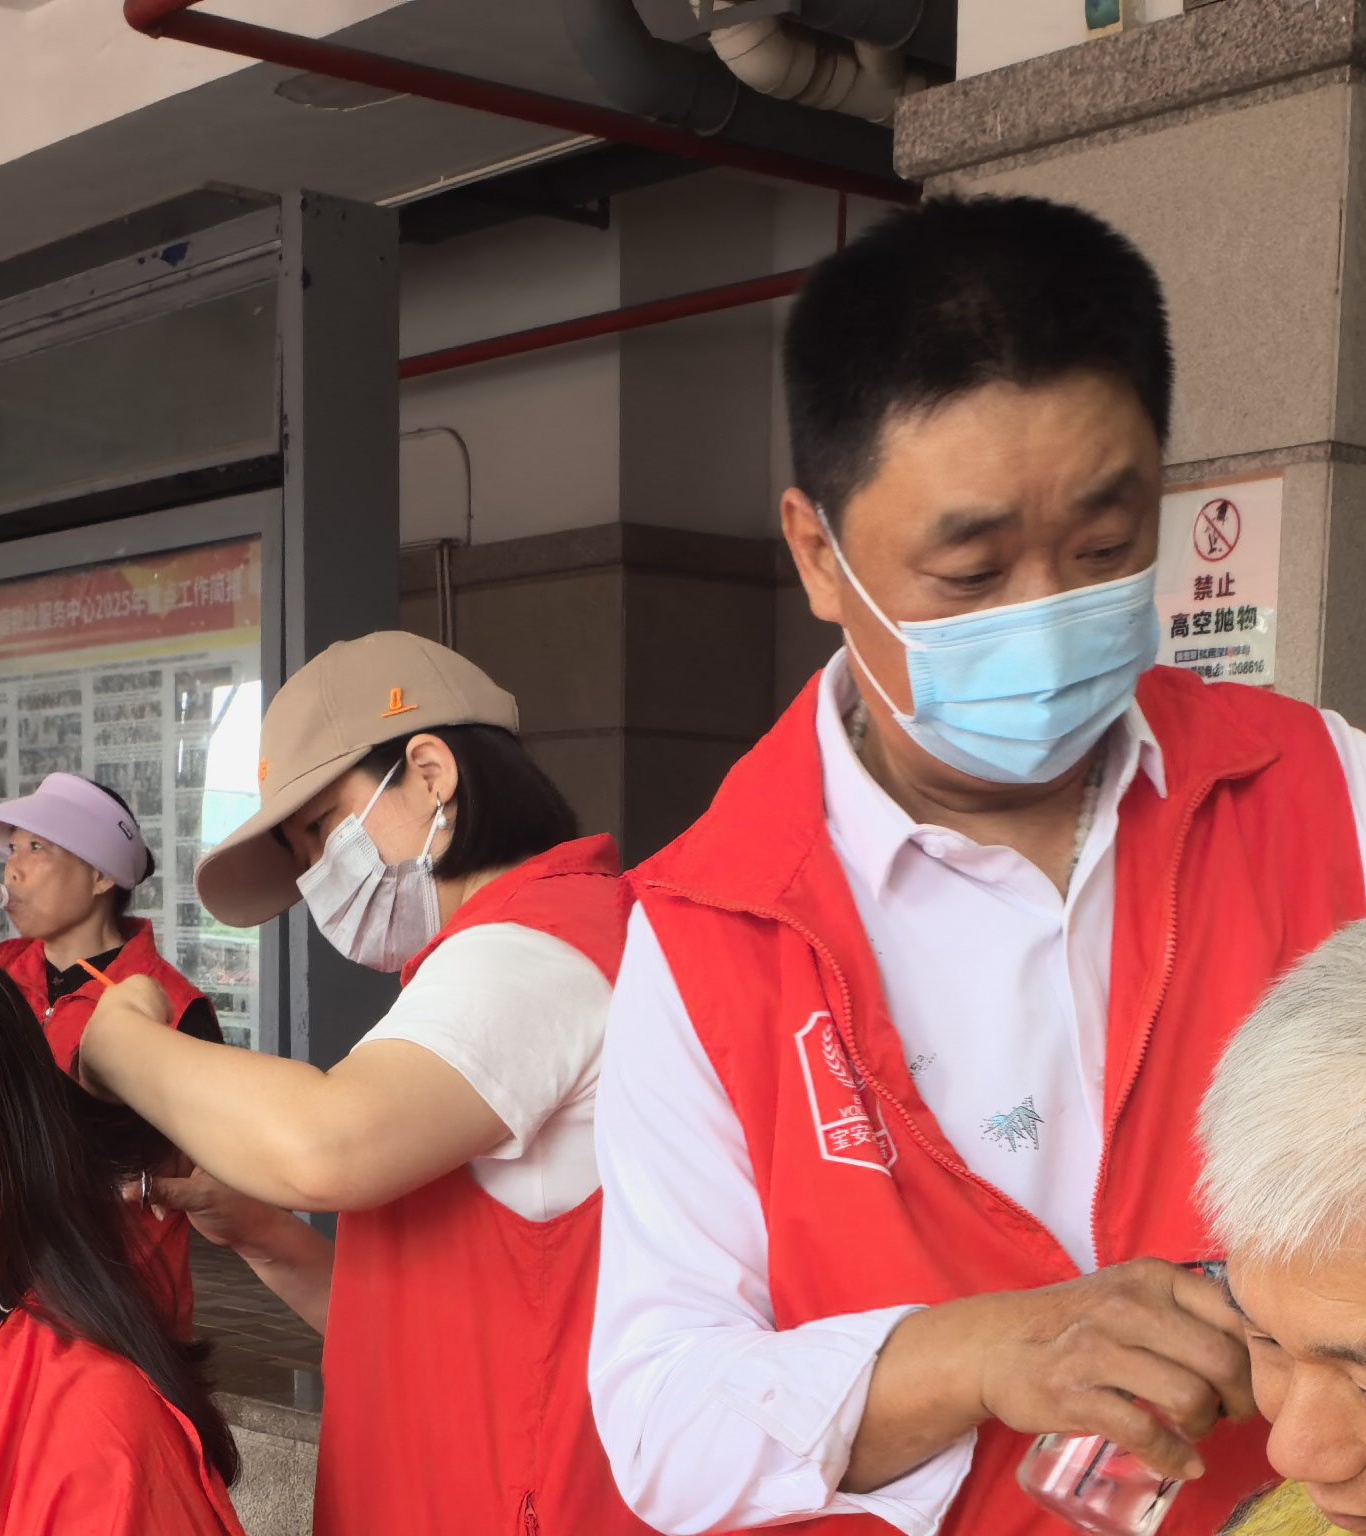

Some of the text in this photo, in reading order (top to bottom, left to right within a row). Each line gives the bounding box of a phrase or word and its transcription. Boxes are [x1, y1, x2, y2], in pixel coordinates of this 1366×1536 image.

[1193, 572, 1236, 601] 禁止
[1170, 605, 1258, 639] 高空抛物
